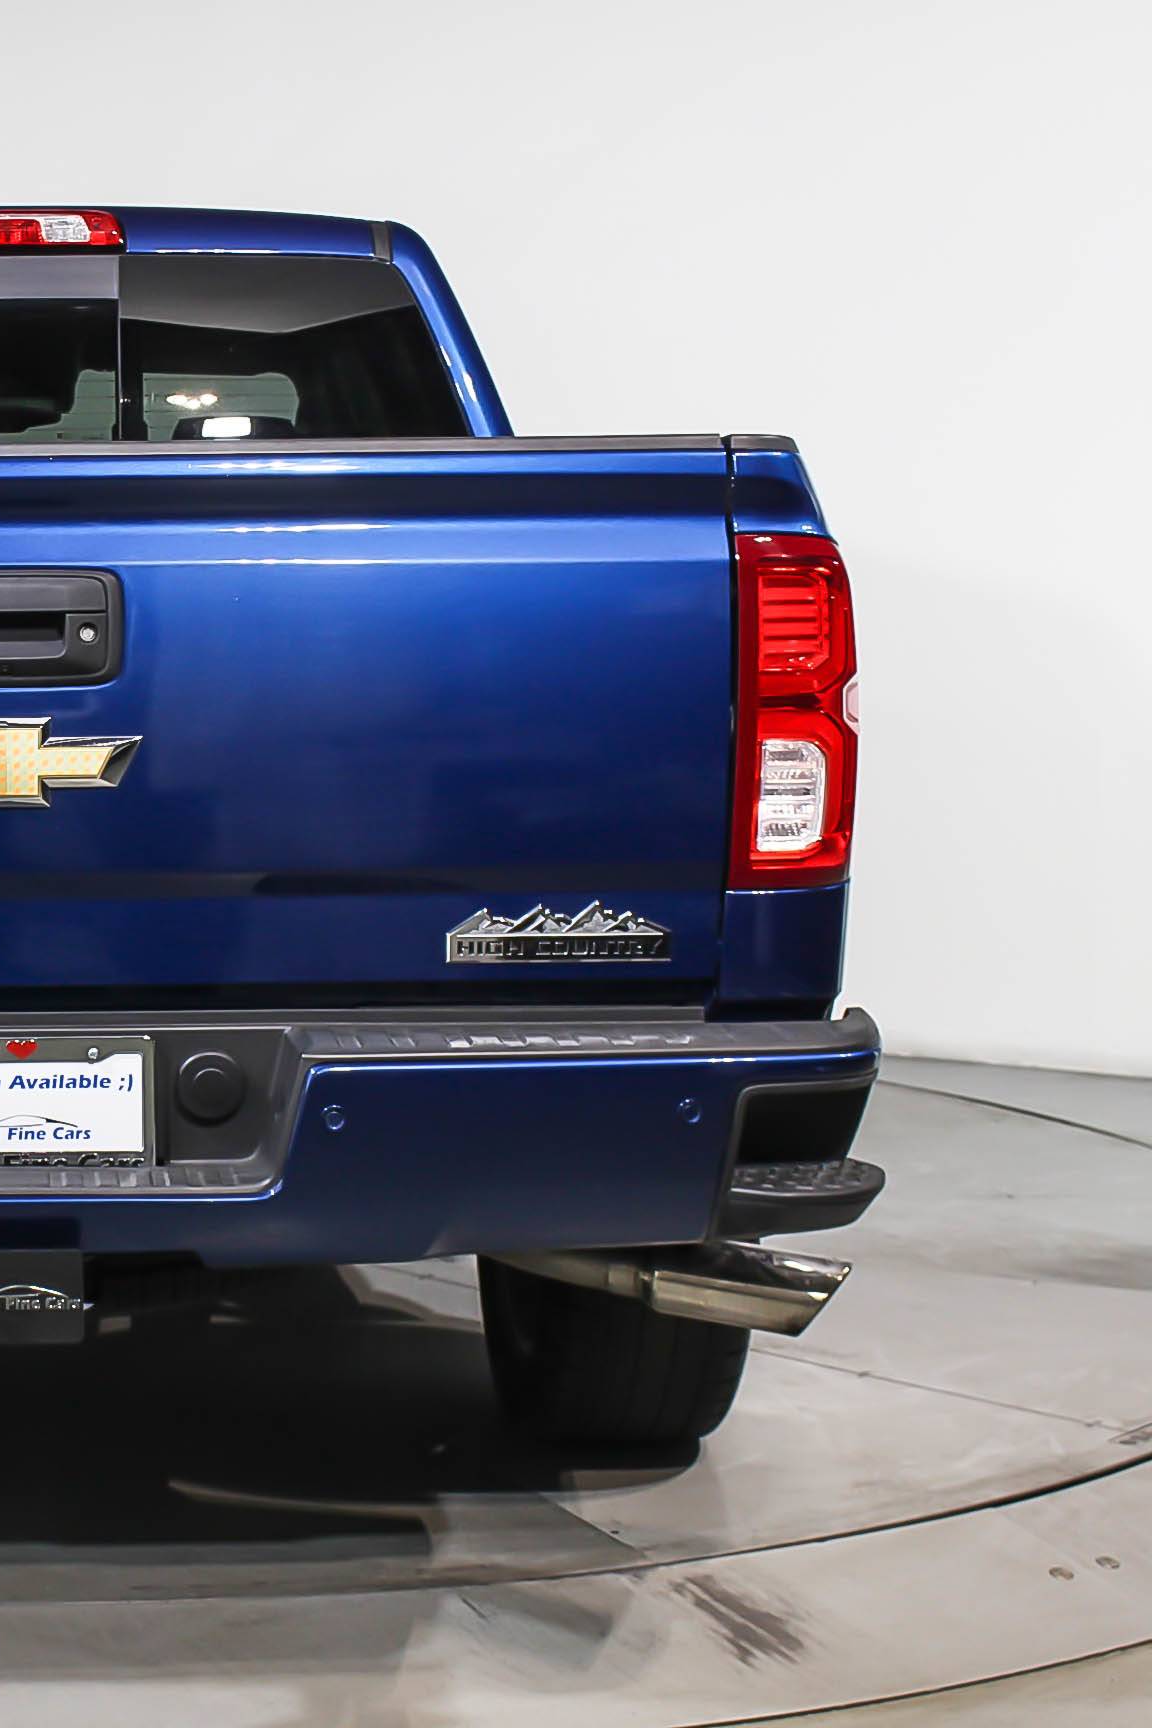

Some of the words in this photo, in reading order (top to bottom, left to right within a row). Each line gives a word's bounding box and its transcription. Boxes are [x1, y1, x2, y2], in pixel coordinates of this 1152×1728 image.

[8, 1074, 112, 1090] Available
[118, 1073, 134, 1092] ;)
[7, 1127, 46, 1141] Fine
[52, 1126, 91, 1141] Cars
